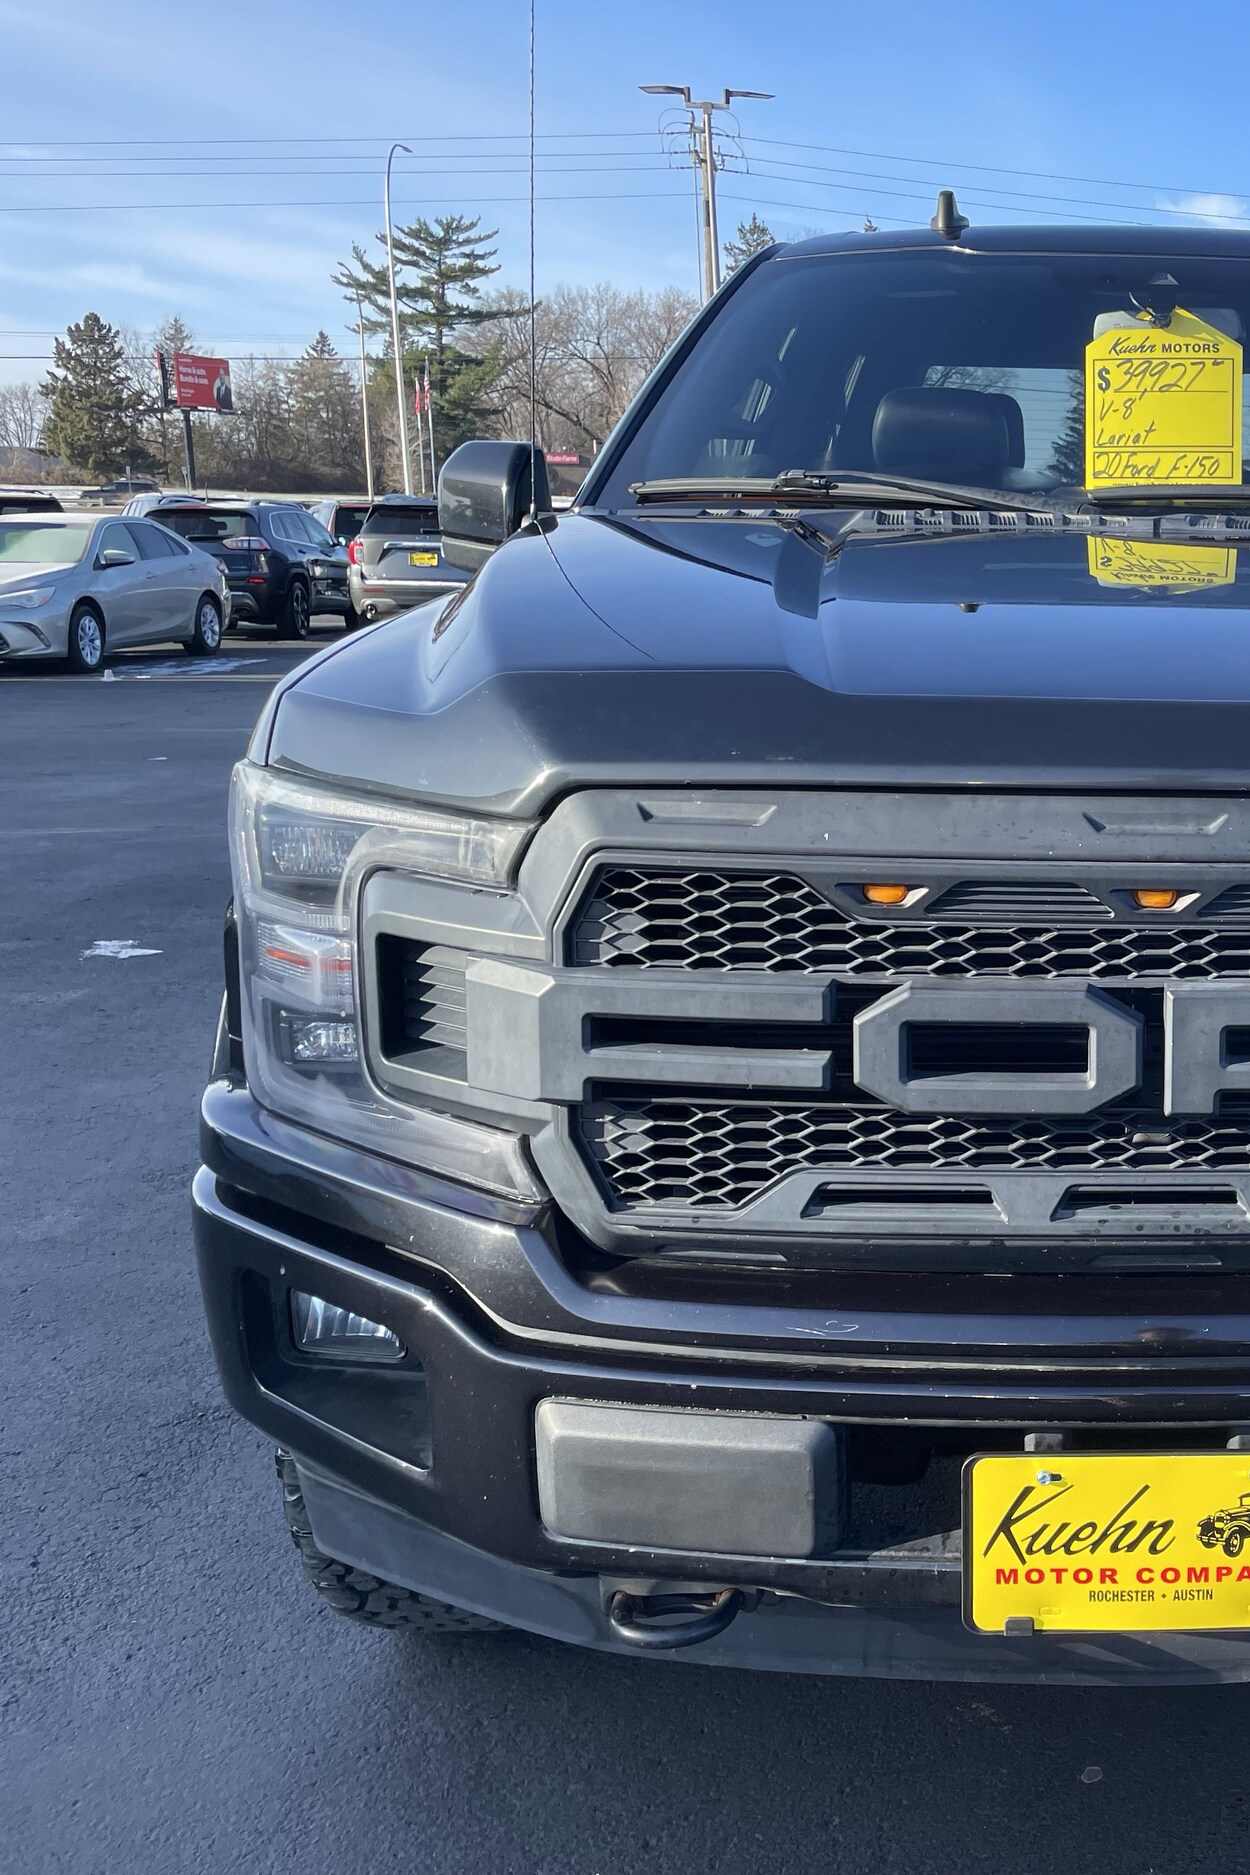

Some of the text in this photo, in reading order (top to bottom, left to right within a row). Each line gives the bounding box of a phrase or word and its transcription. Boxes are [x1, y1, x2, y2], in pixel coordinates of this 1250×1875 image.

[1108, 336, 1221, 356] Kuehn MOTORS
[1099, 397, 1138, 422] V-8
[1096, 420, 1157, 447] Lariat
[1119, 451, 1161, 478] Ford
[1165, 454, 1220, 479] F-150
[983, 1484, 1176, 1566] Kuehn
[995, 1567, 1119, 1585] MOTOR
[1088, 1588, 1214, 1603] ROCHESTER AUSTIN
